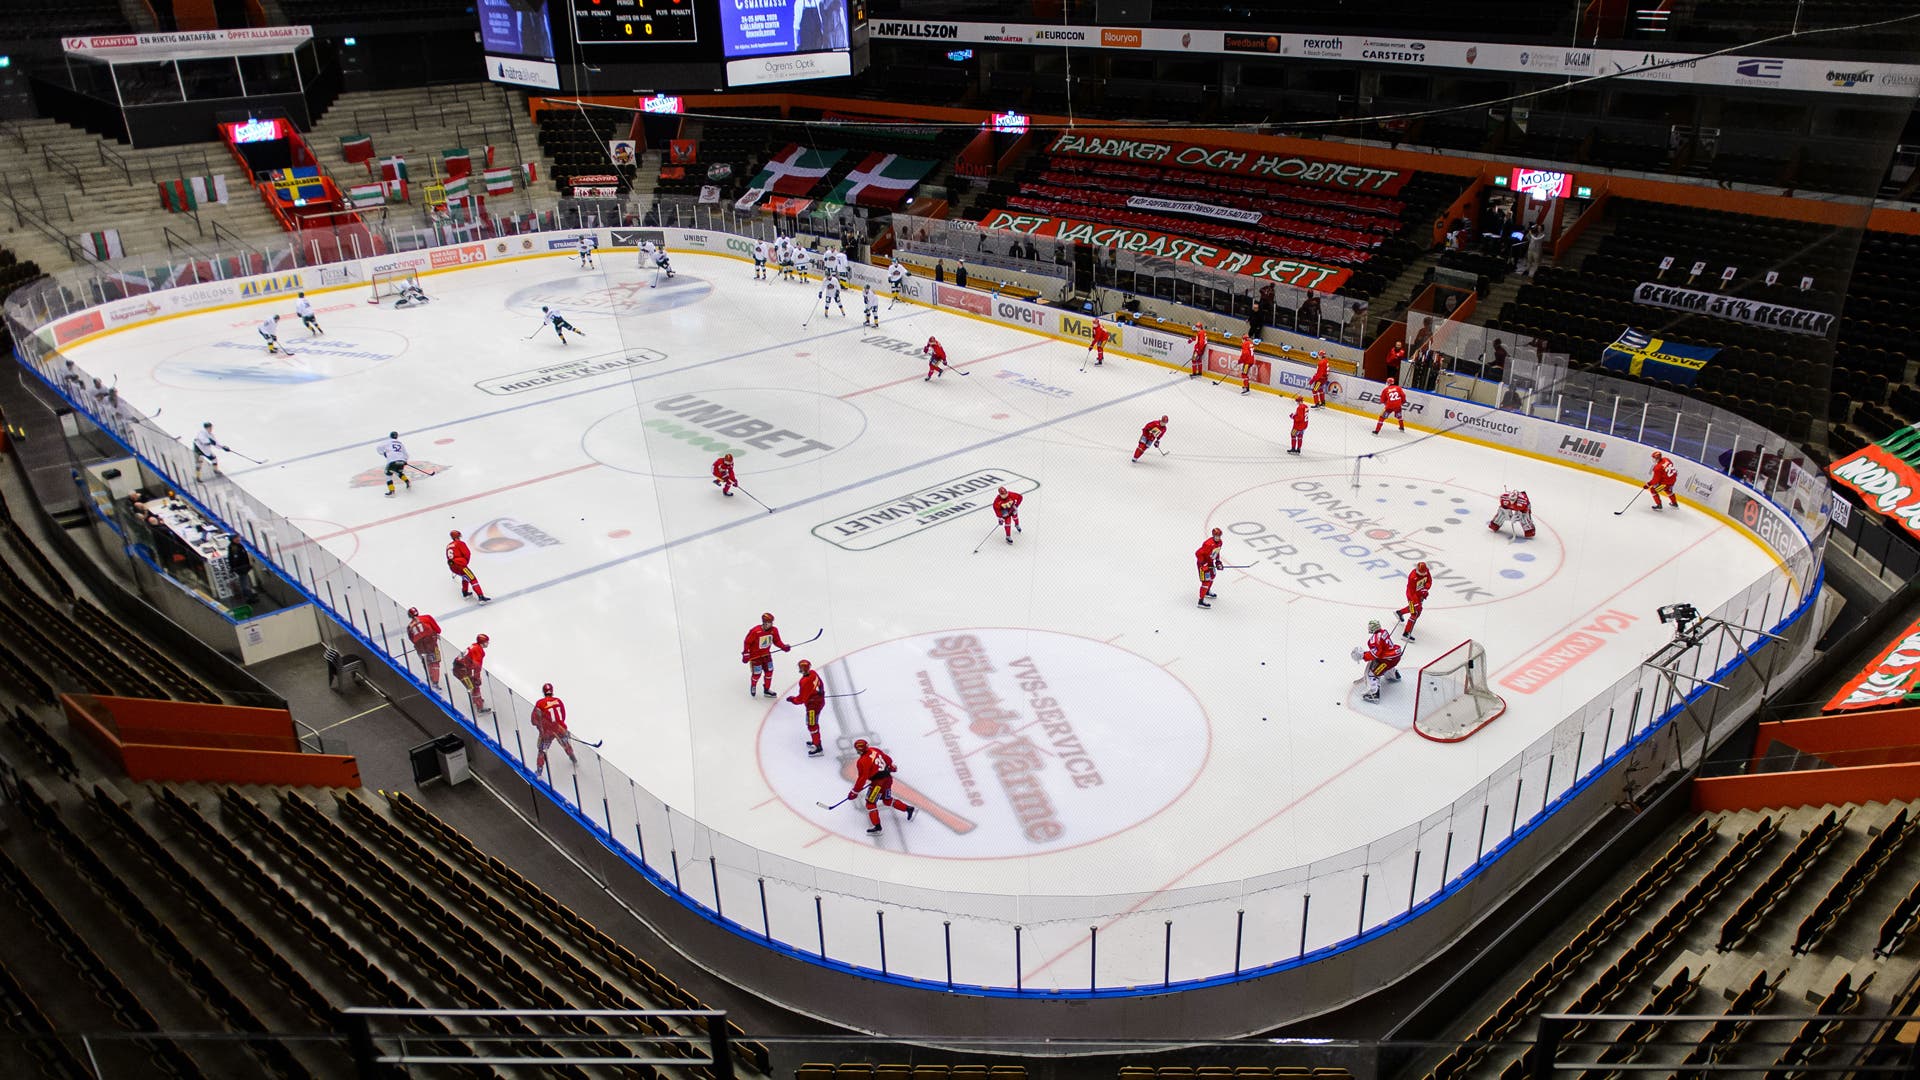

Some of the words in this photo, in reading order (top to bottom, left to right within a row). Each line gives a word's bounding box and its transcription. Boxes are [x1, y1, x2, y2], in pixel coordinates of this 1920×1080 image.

[625, 23, 633, 35] 0
[645, 23, 653, 35] 0
[877, 22, 958, 39] ANFALLSZON
[1045, 30, 1085, 41] EUROCON
[1104, 31, 1138, 44] Nouryon
[66, 38, 87, 50] ICA
[93, 38, 136, 48] KVANTUM
[140, 36, 150, 45] EN
[152, 34, 177, 44] RIKTIG
[178, 32, 216, 43] MATAFFÄR
[227, 31, 250, 40] ÖPPET
[1226, 36, 1266, 48] Swedbank
[1303, 37, 1343, 50] rexroth
[795, 59, 816, 70] Optik
[1362, 50, 1425, 62] CARSTEDTS
[1564, 52, 1591, 66] UGGLAN
[1051, 134, 1172, 161] FABRIKEN
[1176, 147, 1247, 170] OCH
[1521, 172, 1562, 186] MODO
[683, 234, 708, 243] UNIBET
[460, 246, 484, 264] brå
[988, 212, 1051, 236] DET
[1055, 220, 1219, 267] VACKRASTE
[1252, 258, 1339, 289] SETT
[374, 258, 425, 273] sportringen
[1639, 284, 1709, 312] BEVARA
[1710, 297, 1752, 320] 51%
[1753, 305, 1834, 333] REGELN
[1142, 336, 1174, 351] UNIBET
[499, 353, 653, 393] HOCKEYKVALET
[538, 359, 591, 375] UNIBET
[1358, 390, 1425, 414] BAER
[1388, 391, 1401, 401] 22
[653, 394, 836, 458] UNIBET
[1456, 411, 1520, 435] Constructor
[1559, 434, 1608, 458] Hilli
[833, 473, 1005, 537] HOCKEYKVALET
[915, 501, 977, 527] UNIBET
[1278, 506, 1409, 582] AIRPORT
[1227, 520, 1342, 589] OER.SE
[1580, 608, 1639, 634] ICA
[1509, 635, 1599, 689] KVANTUM
[1008, 655, 1105, 789] VVS-SERVICE
